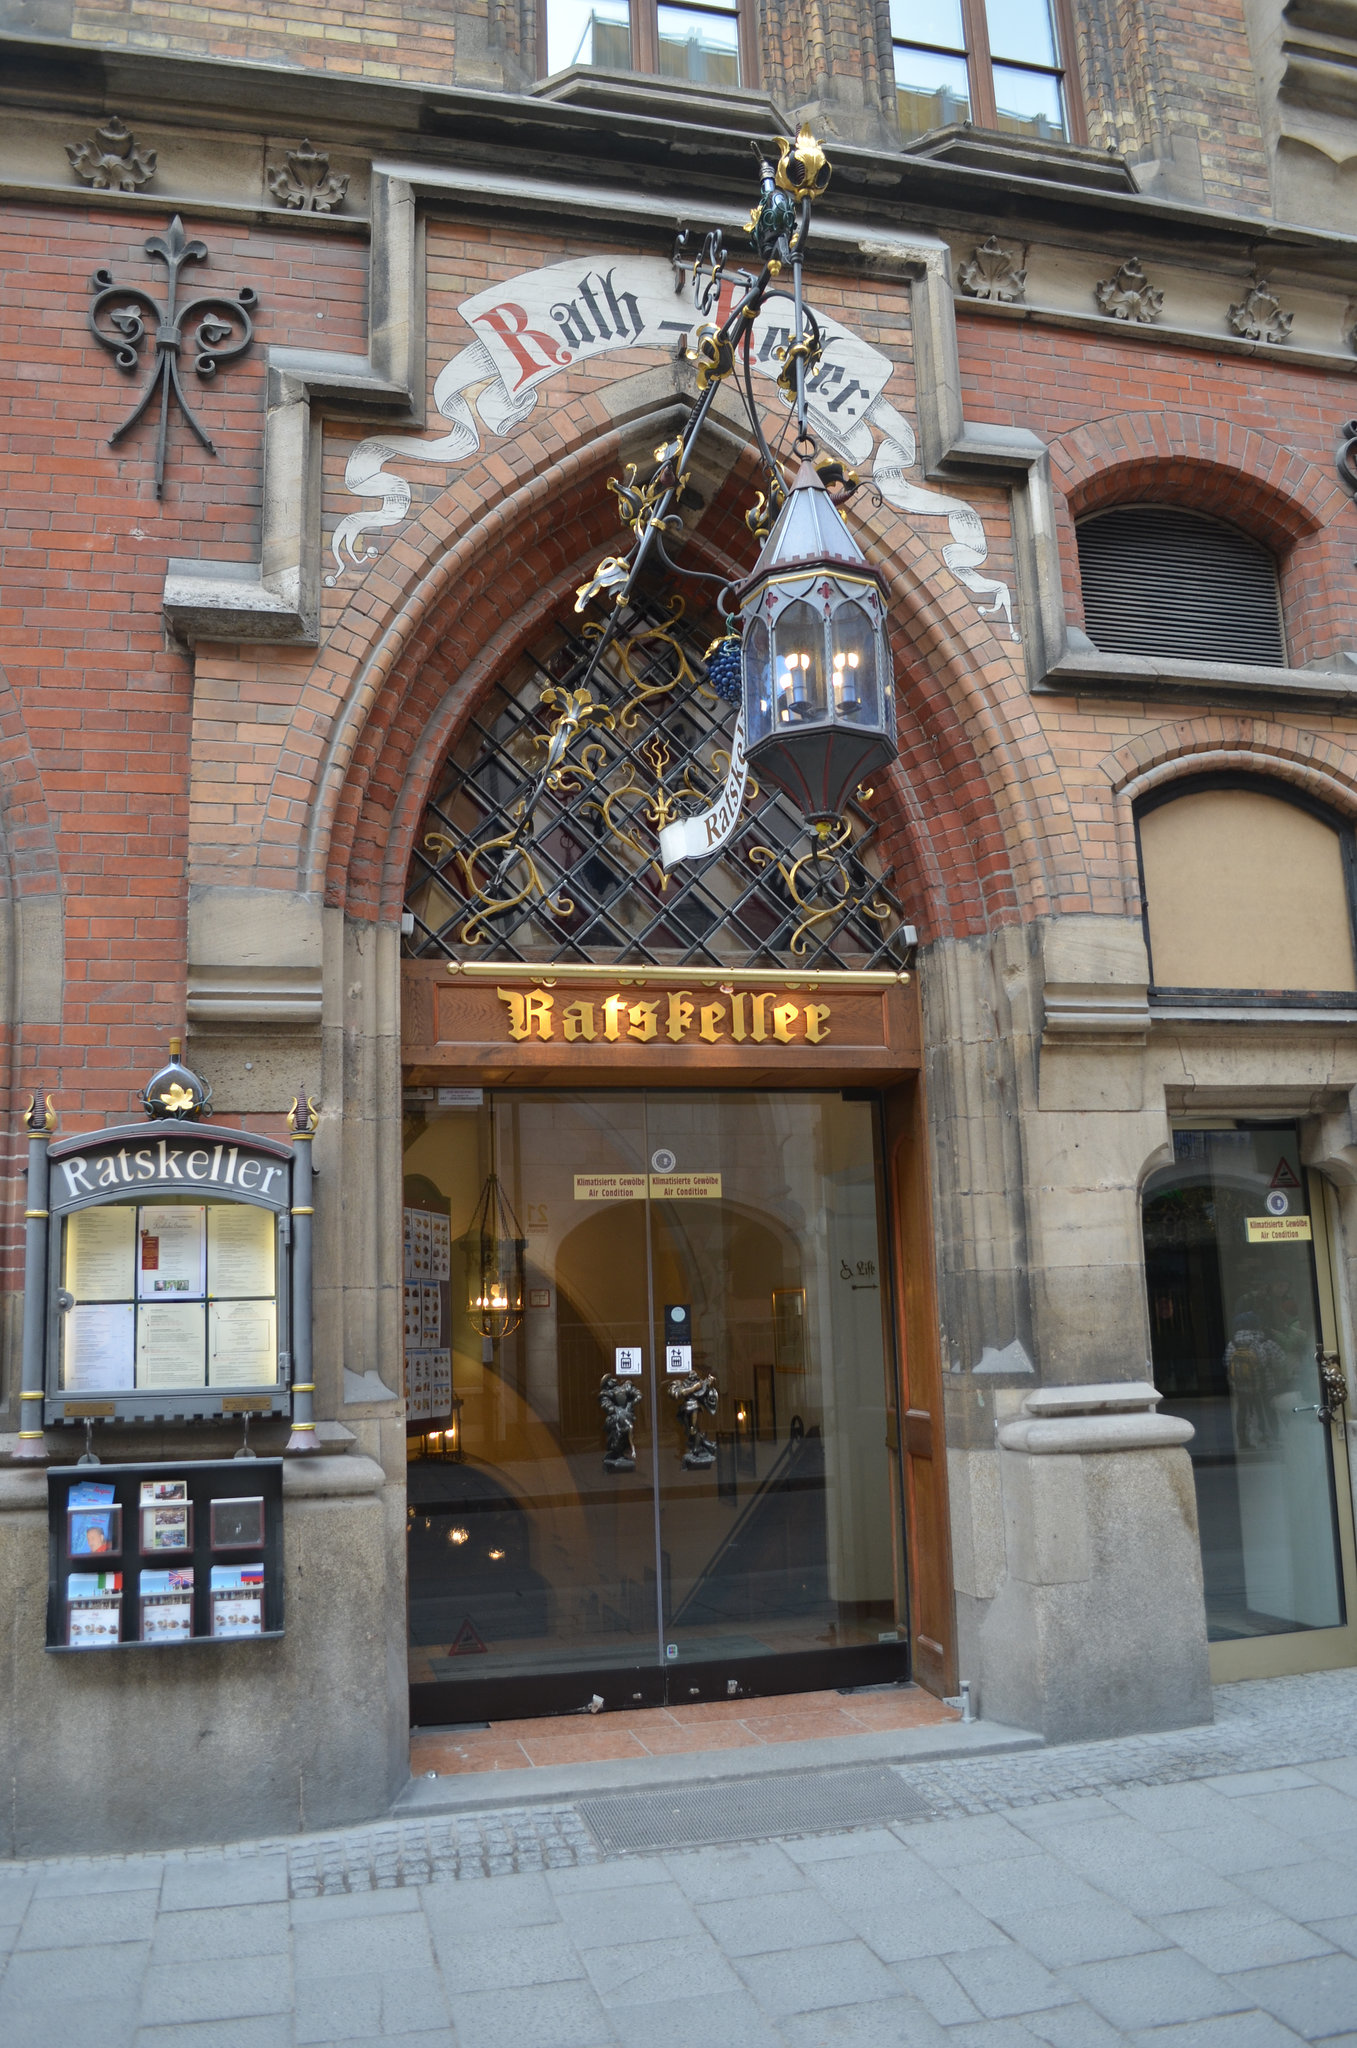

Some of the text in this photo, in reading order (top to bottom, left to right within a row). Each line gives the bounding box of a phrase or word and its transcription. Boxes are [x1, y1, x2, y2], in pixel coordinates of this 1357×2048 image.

[472, 266, 646, 392] Rath
[497, 986, 831, 1044] Ratskeller
[58, 1140, 282, 1197] Ratskeller
[577, 1178, 617, 1186] Klimatisierte
[652, 1177, 691, 1185] Klimatisierte
[588, 1188, 634, 1197] Air Condition
[664, 1187, 708, 1196] Air Condition
[1250, 1221, 1284, 1229] Klimatisierte
[1272, 1231, 1299, 1239] Condition
